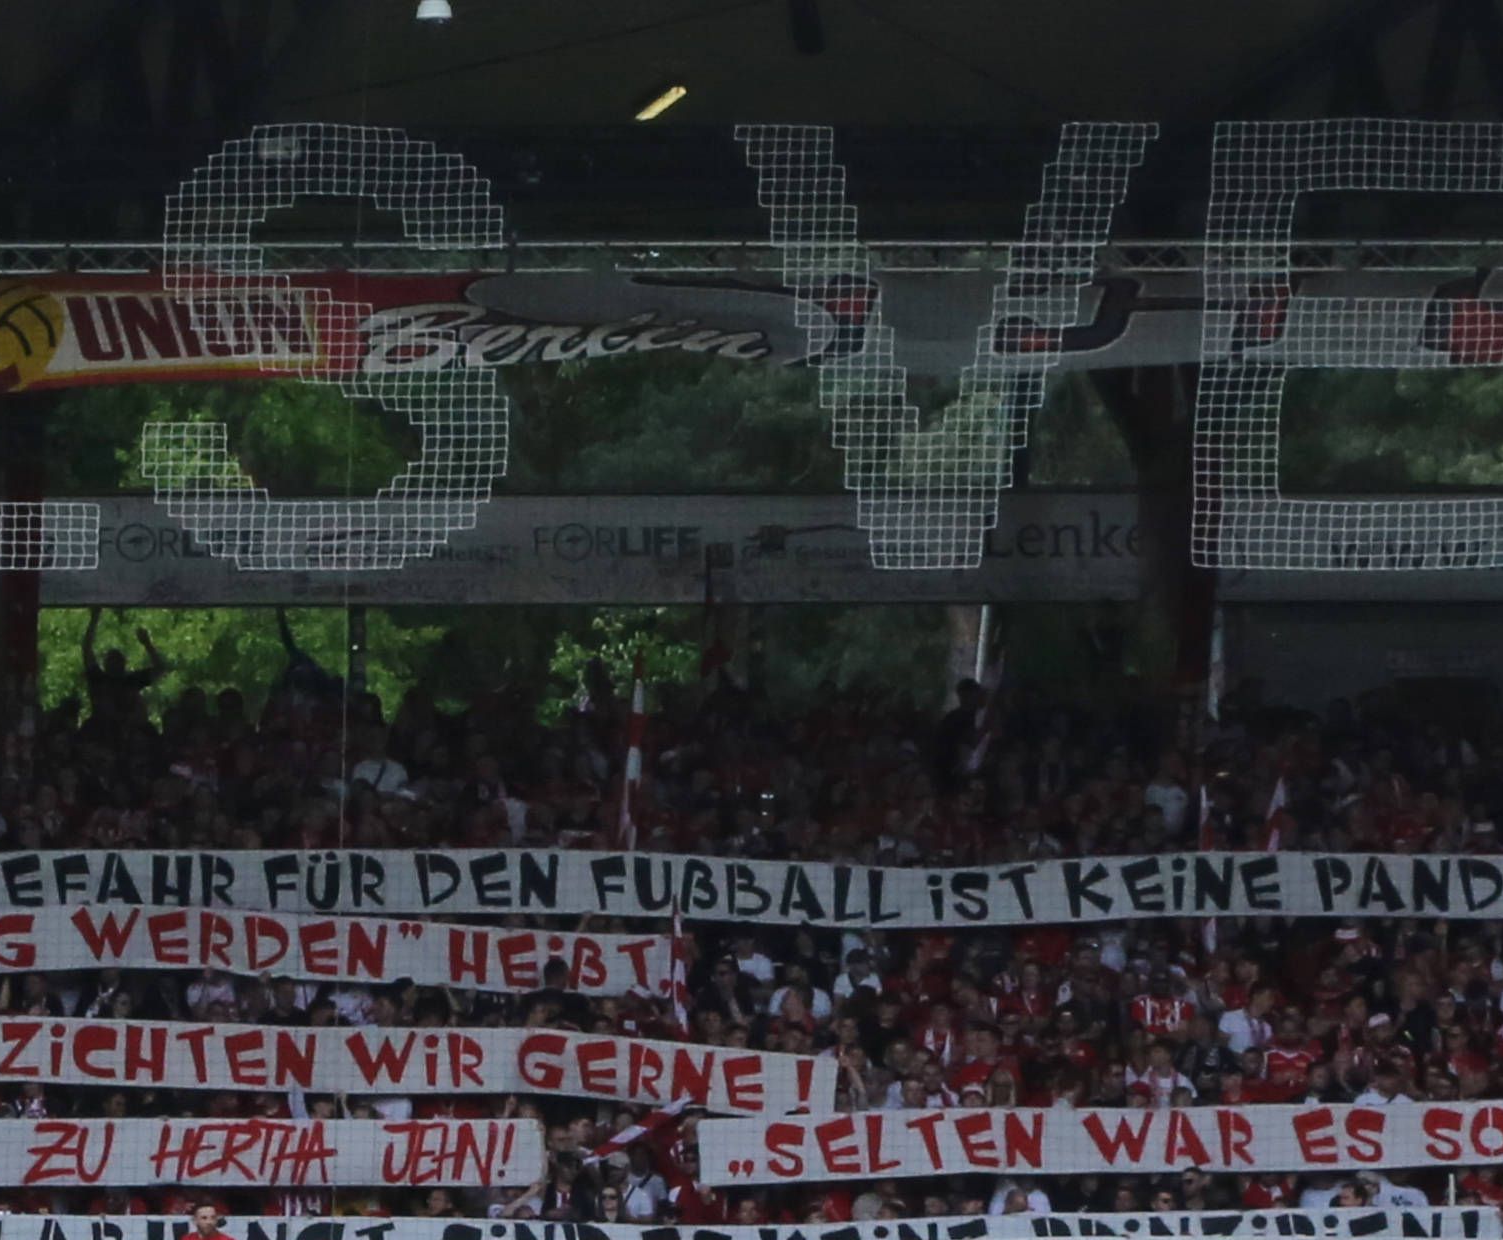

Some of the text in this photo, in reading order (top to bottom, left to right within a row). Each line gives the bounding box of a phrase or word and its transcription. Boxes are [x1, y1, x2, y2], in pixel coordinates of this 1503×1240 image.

[66, 292, 310, 363] UNION
[534, 526, 700, 559] FORLIFE
[262, 850, 385, 911] FÜR
[412, 851, 560, 909] DEN
[24, 1120, 116, 1185] ZU
[149, 1118, 338, 1186] HERTHA
[1082, 1107, 1255, 1167] WAR
[1293, 1108, 1387, 1165] ES
